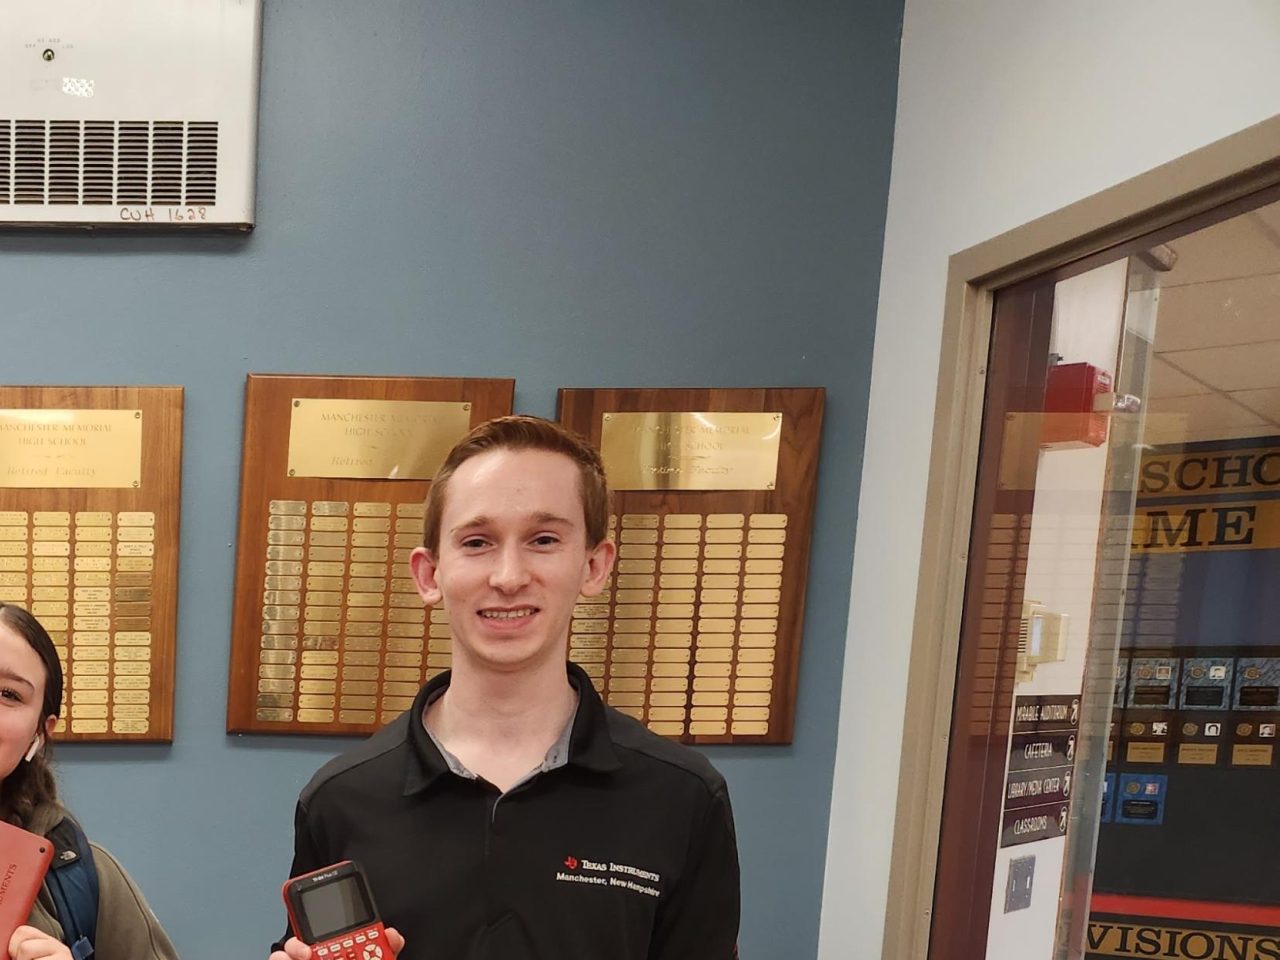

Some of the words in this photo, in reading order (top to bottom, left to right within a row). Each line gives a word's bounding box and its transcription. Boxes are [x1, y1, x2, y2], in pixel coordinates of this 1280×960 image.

[168, 207, 207, 221] 1628
[62, 424, 112, 432] MEMORIAL
[18, 437, 45, 446] HIGH
[48, 437, 86, 446] SCHOOL
[1130, 506, 1257, 549] ME
[1024, 742, 1053, 760] CAFETERIA
[1043, 777, 1061, 794] CENTER
[1013, 815, 1048, 835] CLASSROOMS
[556, 872, 608, 886] Manchester,
[610, 877, 627, 887] New
[627, 881, 661, 897] Hampshire
